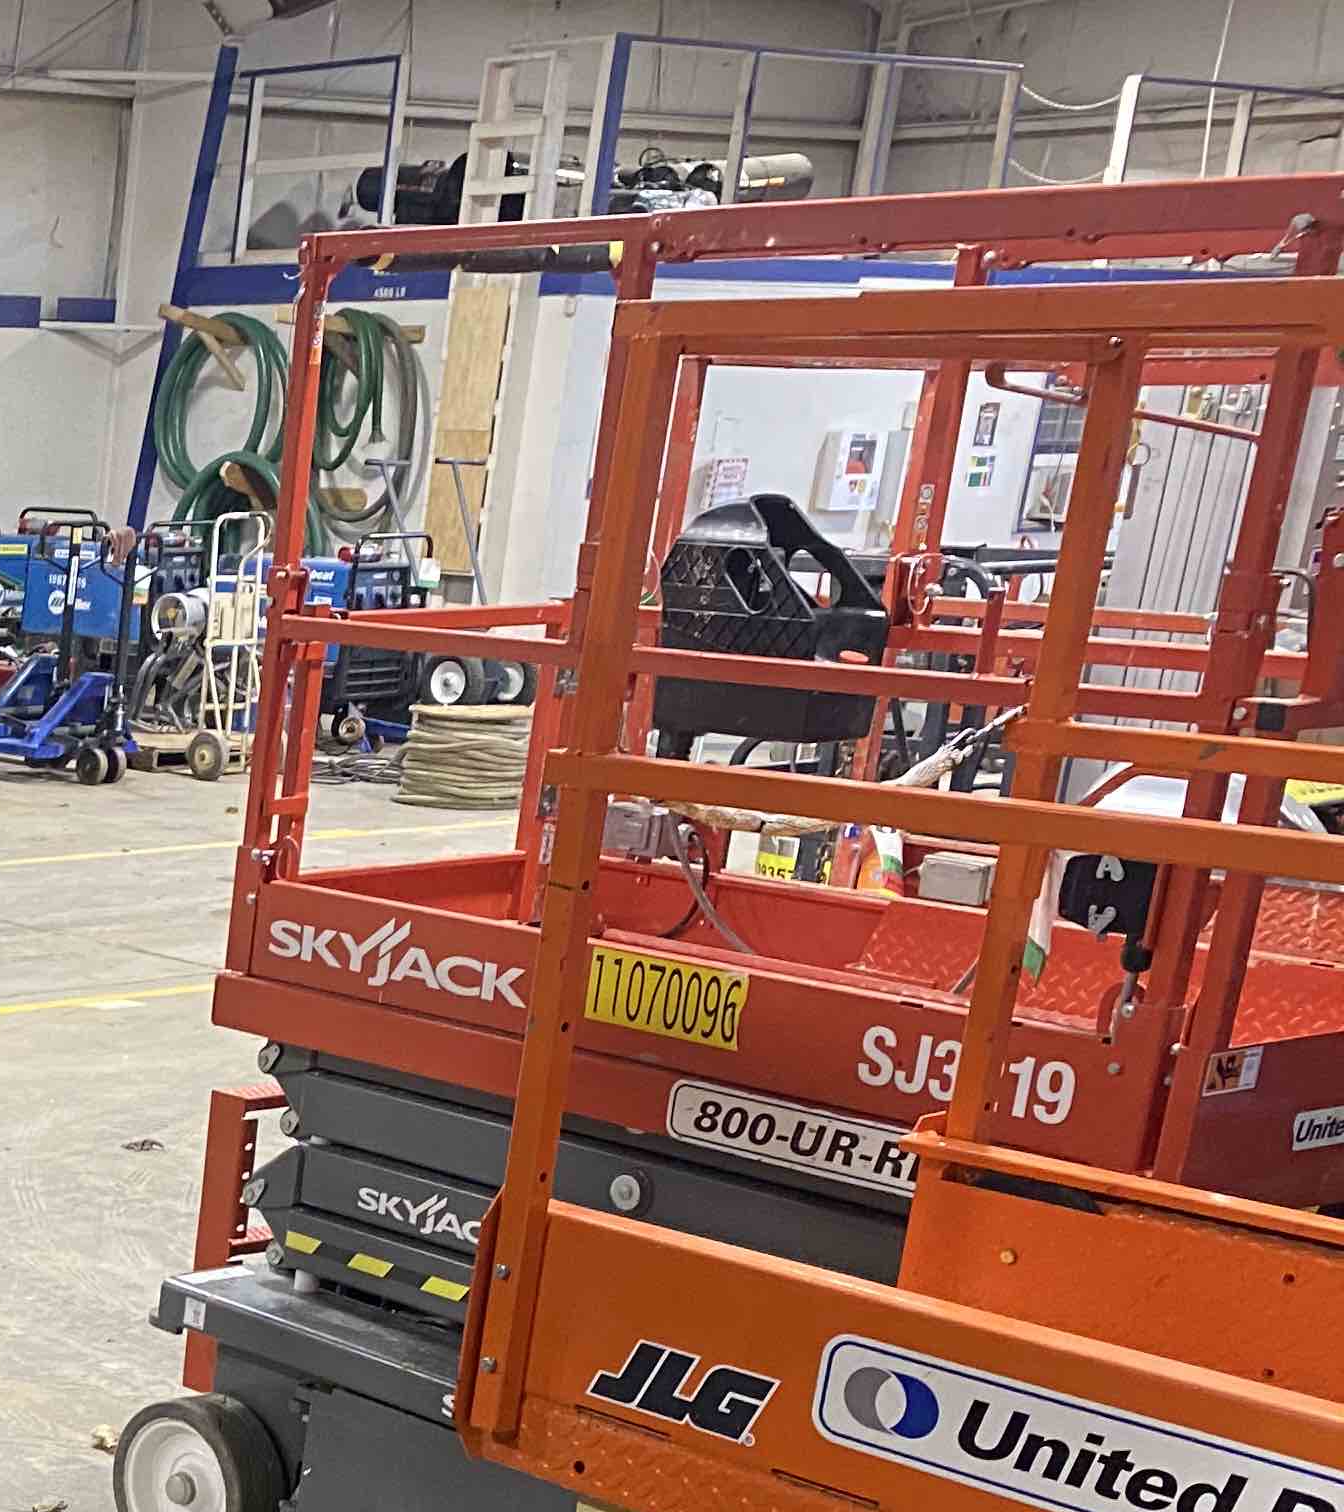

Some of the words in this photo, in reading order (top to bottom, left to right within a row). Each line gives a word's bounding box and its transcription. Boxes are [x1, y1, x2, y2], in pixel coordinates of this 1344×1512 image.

[268, 917, 526, 1009] SKYJACK
[592, 953, 742, 1043] 11070096
[857, 1025, 1076, 1126] SJ319
[358, 1187, 481, 1244] SKYJAC
[586, 1338, 782, 1444] JLG
